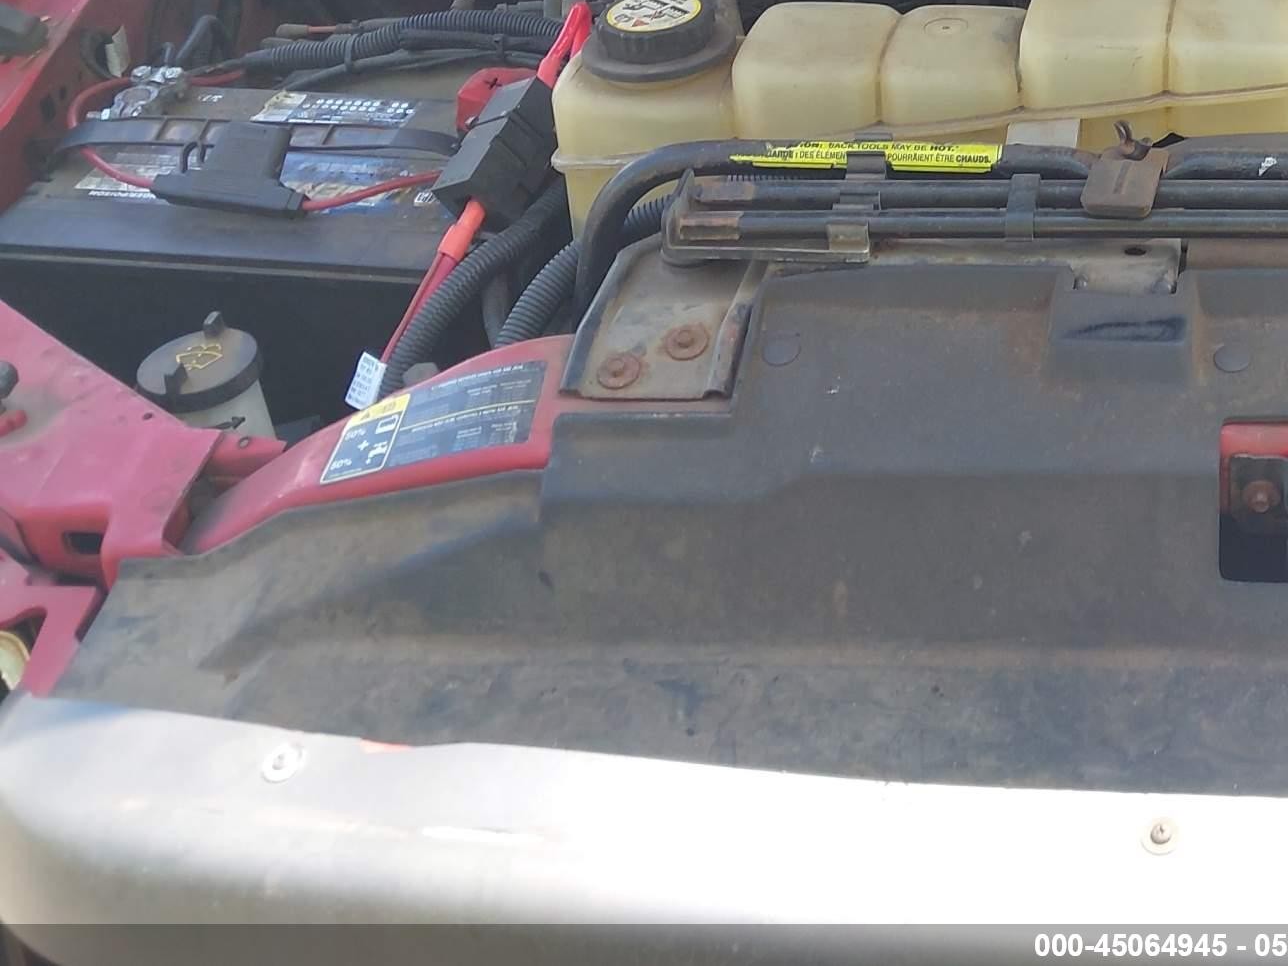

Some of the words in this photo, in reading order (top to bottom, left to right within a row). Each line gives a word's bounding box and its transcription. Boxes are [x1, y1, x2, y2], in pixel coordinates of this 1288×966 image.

[856, 141, 889, 150] TOOLS
[891, 143, 912, 151] MAY
[800, 150, 814, 160] DES
[887, 151, 934, 163] POURRAIENT
[956, 154, 992, 164] CHAUDS.
